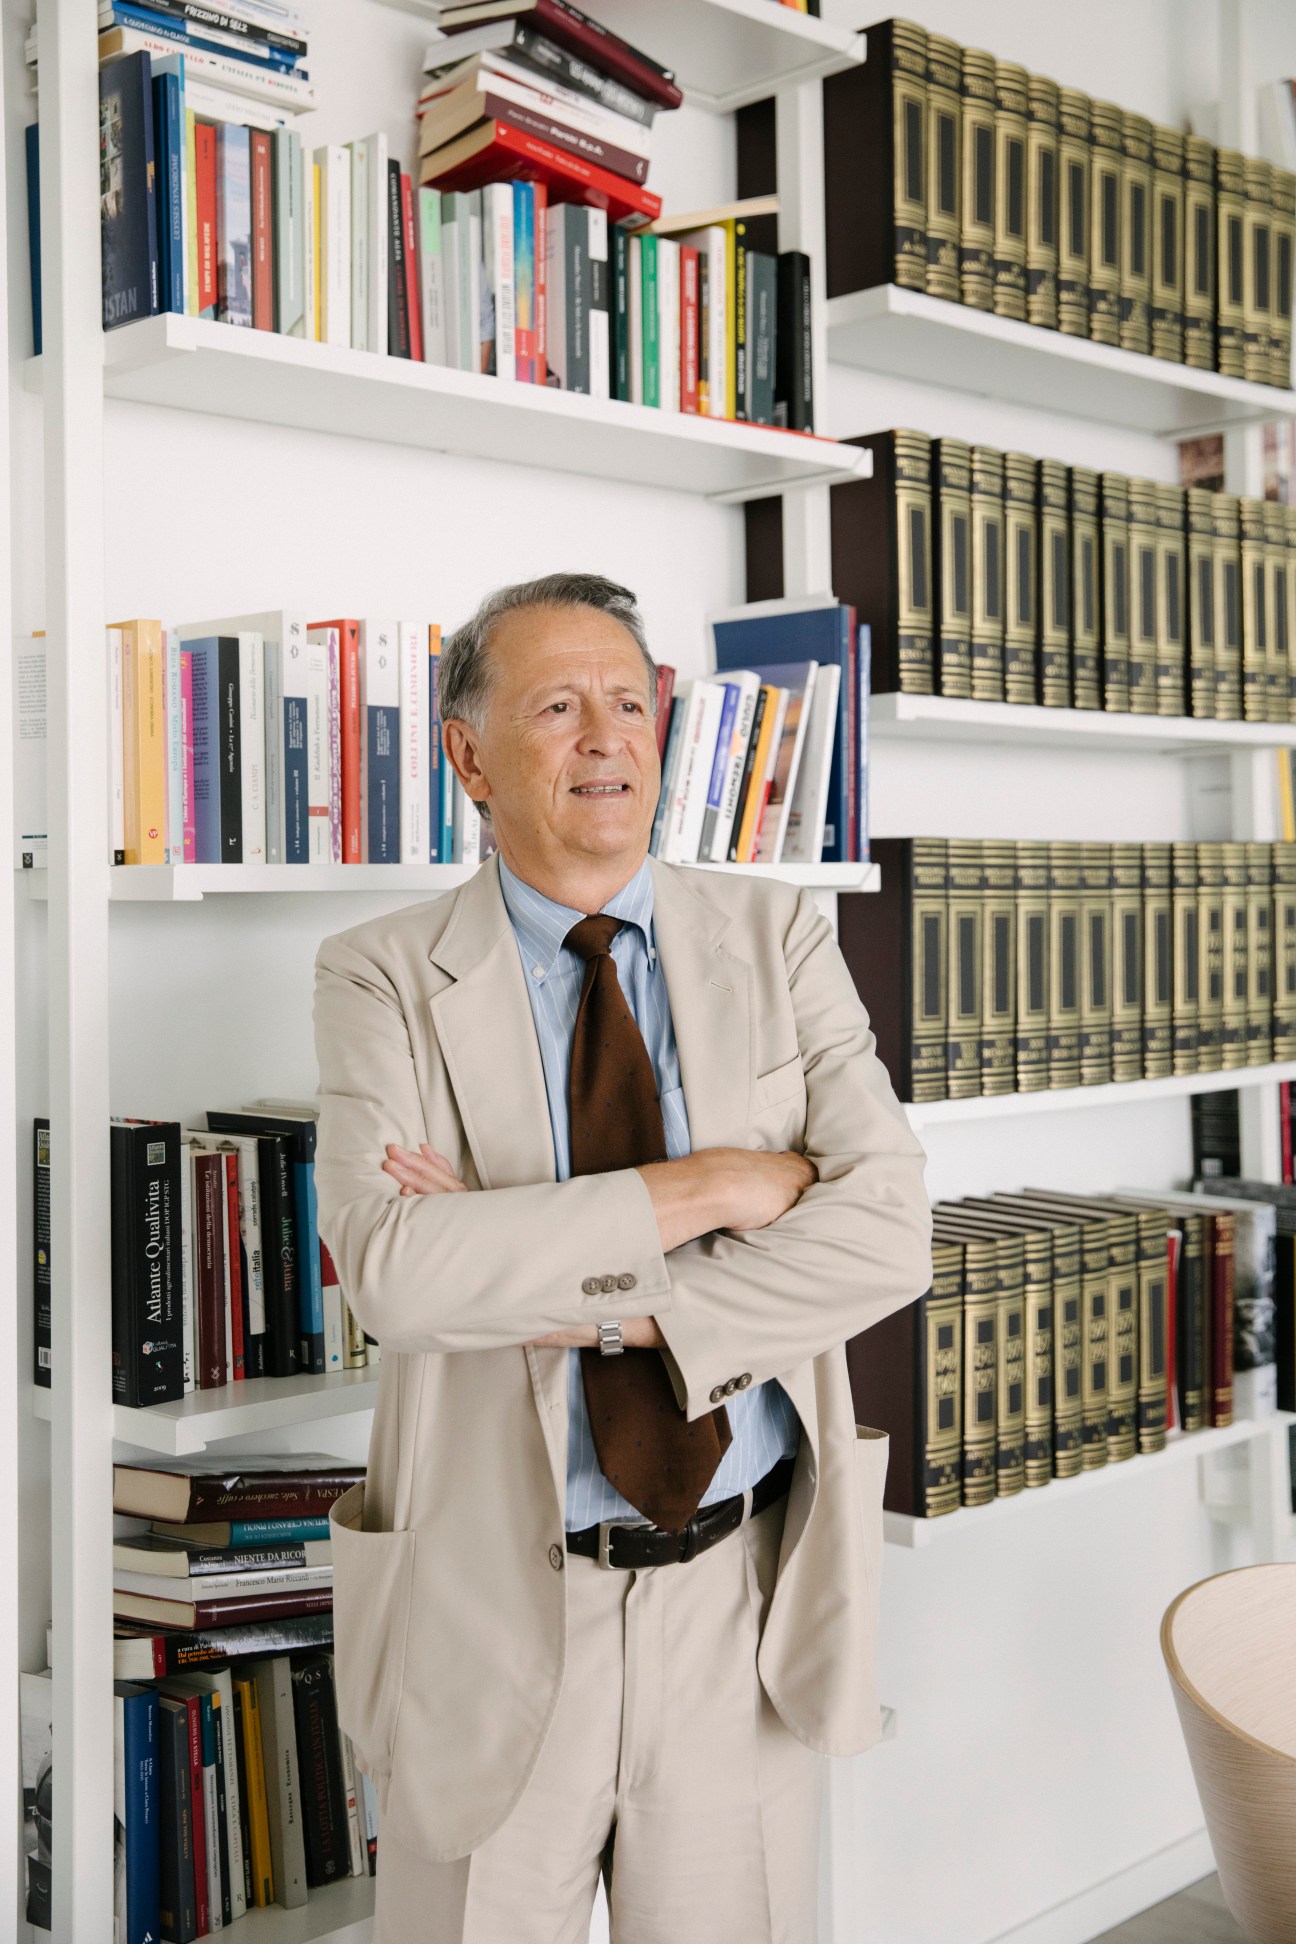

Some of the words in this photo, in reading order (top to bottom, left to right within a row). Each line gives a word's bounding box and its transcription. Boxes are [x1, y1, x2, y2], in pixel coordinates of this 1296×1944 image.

[144, 40, 164, 51] ALDO
[171, 153, 180, 205] SYNDROME
[173, 205, 181, 241] ULYSSES
[170, 646, 178, 668] BEDA
[409, 633, 419, 704] CIMINIERE
[409, 721, 419, 778] COLLINE
[162, 1179, 170, 1194] STG
[145, 1178, 165, 1259] Qualivita
[164, 1248, 173, 1291] agroalimentari
[249, 1250, 263, 1293] reteitalia
[146, 1260, 162, 1324] Atlante
[165, 1293, 173, 1317] prodotti
[242, 1492, 279, 1504] zucchero
[234, 1554, 267, 1565] NIENTE
[267, 1552, 281, 1563] DA
[235, 1579, 266, 1588] Francesco
[266, 1575, 285, 1586] Maria
[285, 1572, 310, 1583] Riccardi
[192, 1737, 198, 1746] LA
[287, 1792, 295, 1825] Rassegna
